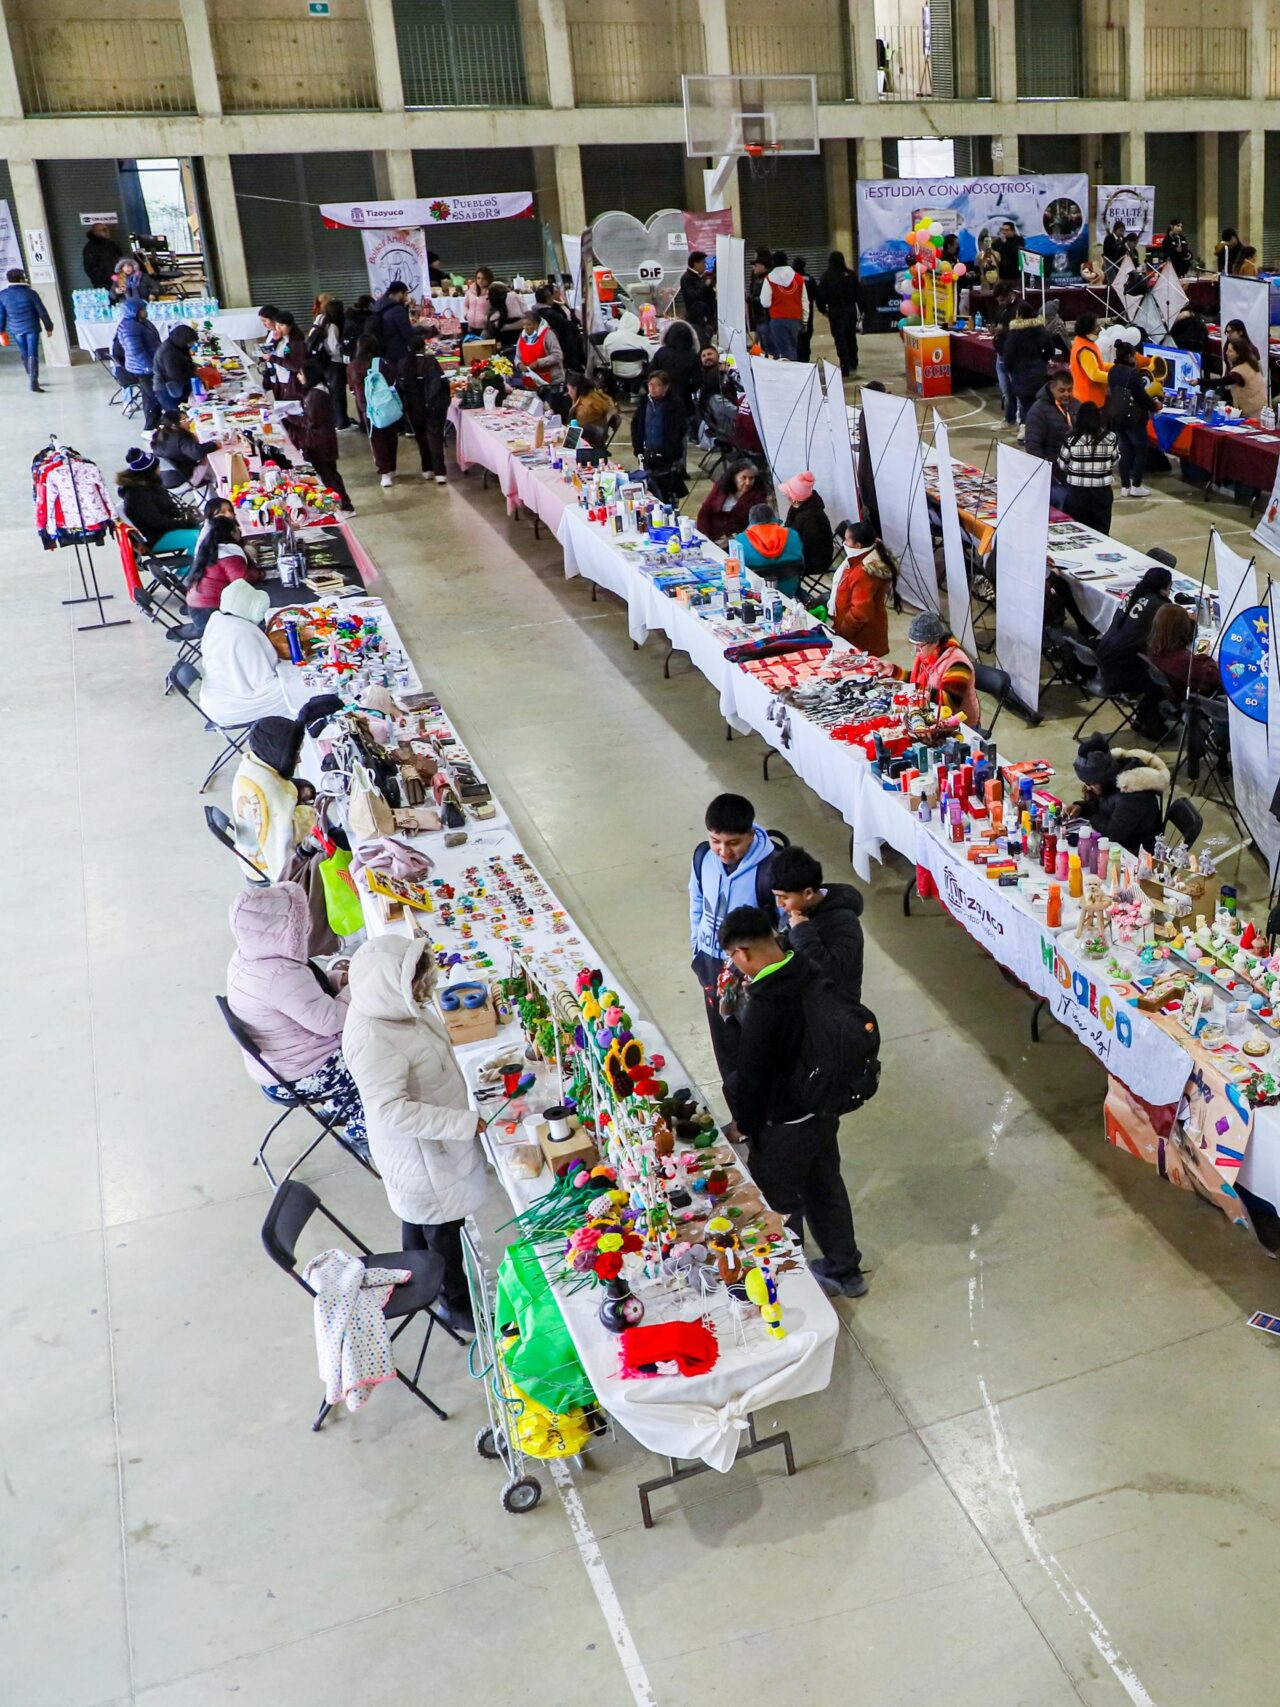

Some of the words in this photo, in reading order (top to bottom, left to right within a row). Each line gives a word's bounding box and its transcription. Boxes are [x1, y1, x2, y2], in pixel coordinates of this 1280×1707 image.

[928, 183, 958, 197] CON
[452, 196, 498, 208] PUEBLOS
[366, 209, 404, 220] Tizayuca
[458, 208, 494, 220] SABOR
[1230, 633, 1242, 643] 80
[1247, 664, 1257, 672] 70
[1245, 698, 1258, 706] 60
